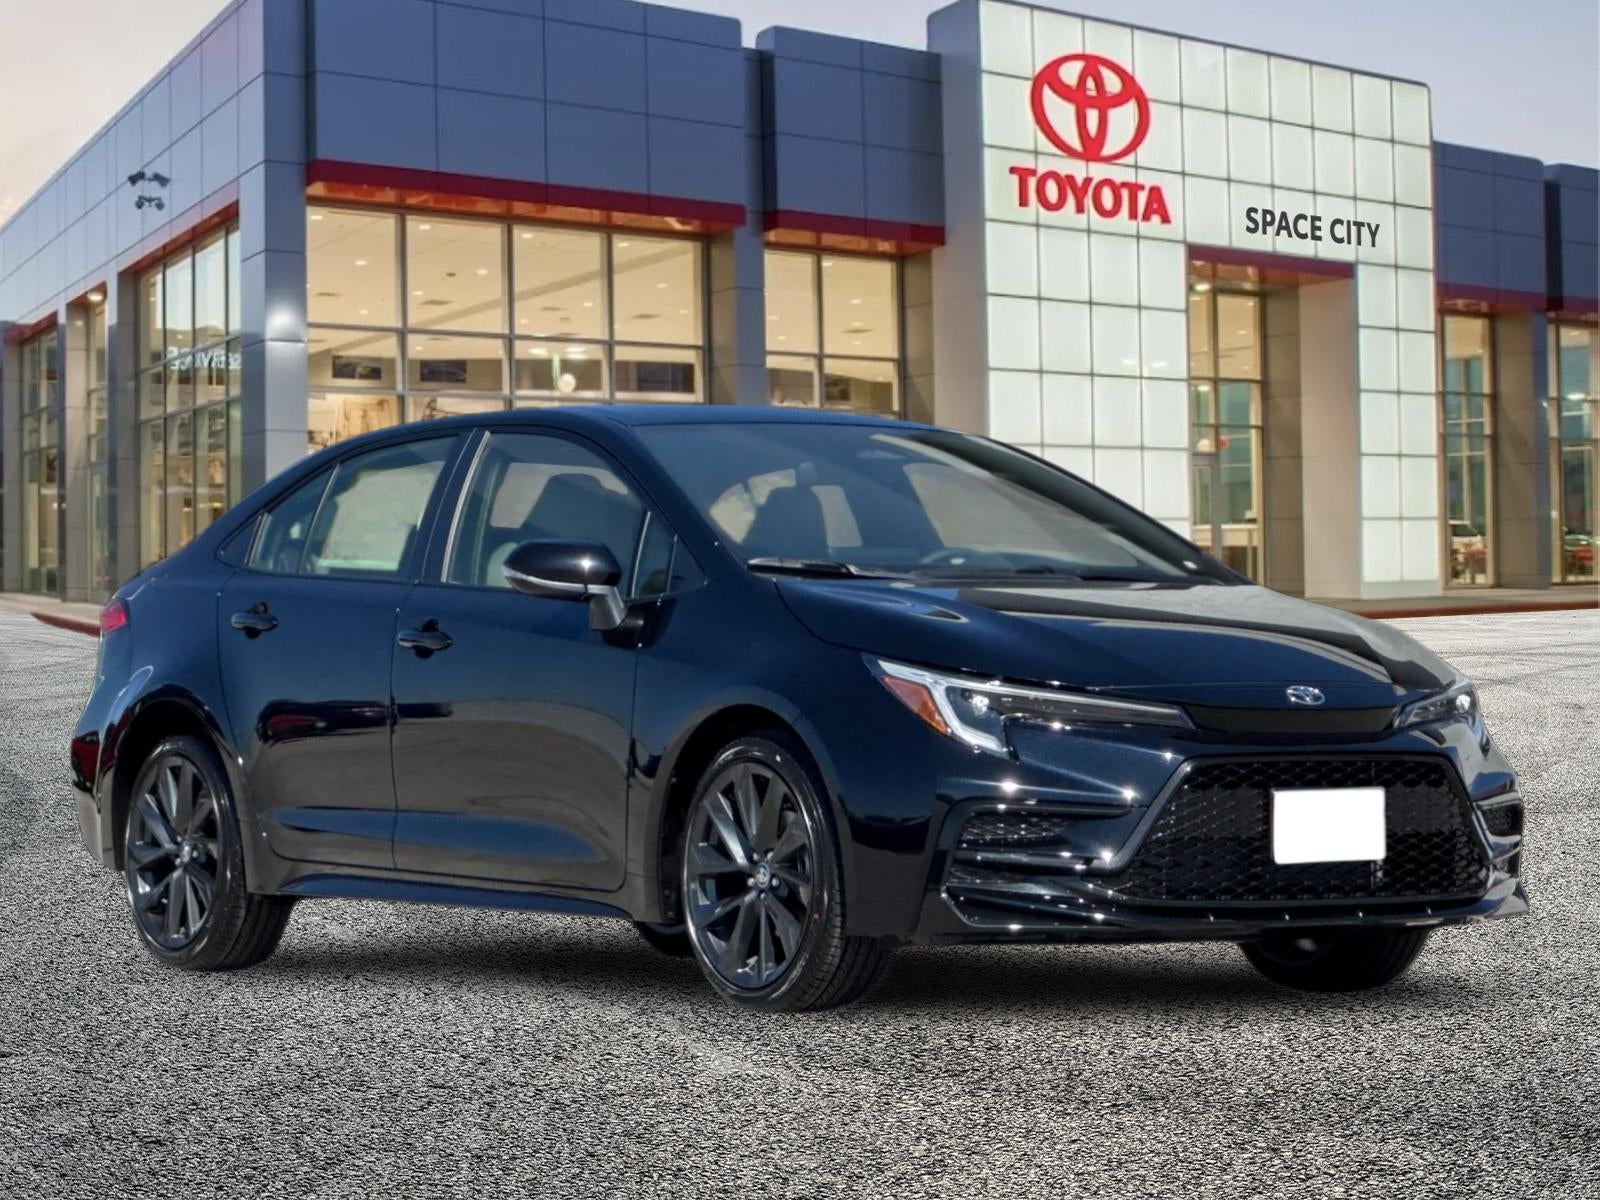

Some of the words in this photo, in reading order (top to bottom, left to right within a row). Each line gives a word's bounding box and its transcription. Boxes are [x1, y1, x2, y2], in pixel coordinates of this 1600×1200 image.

[1009, 167, 1171, 225] TOYOTA
[1245, 207, 1323, 241] SPACE
[1329, 218, 1380, 248] CITY
